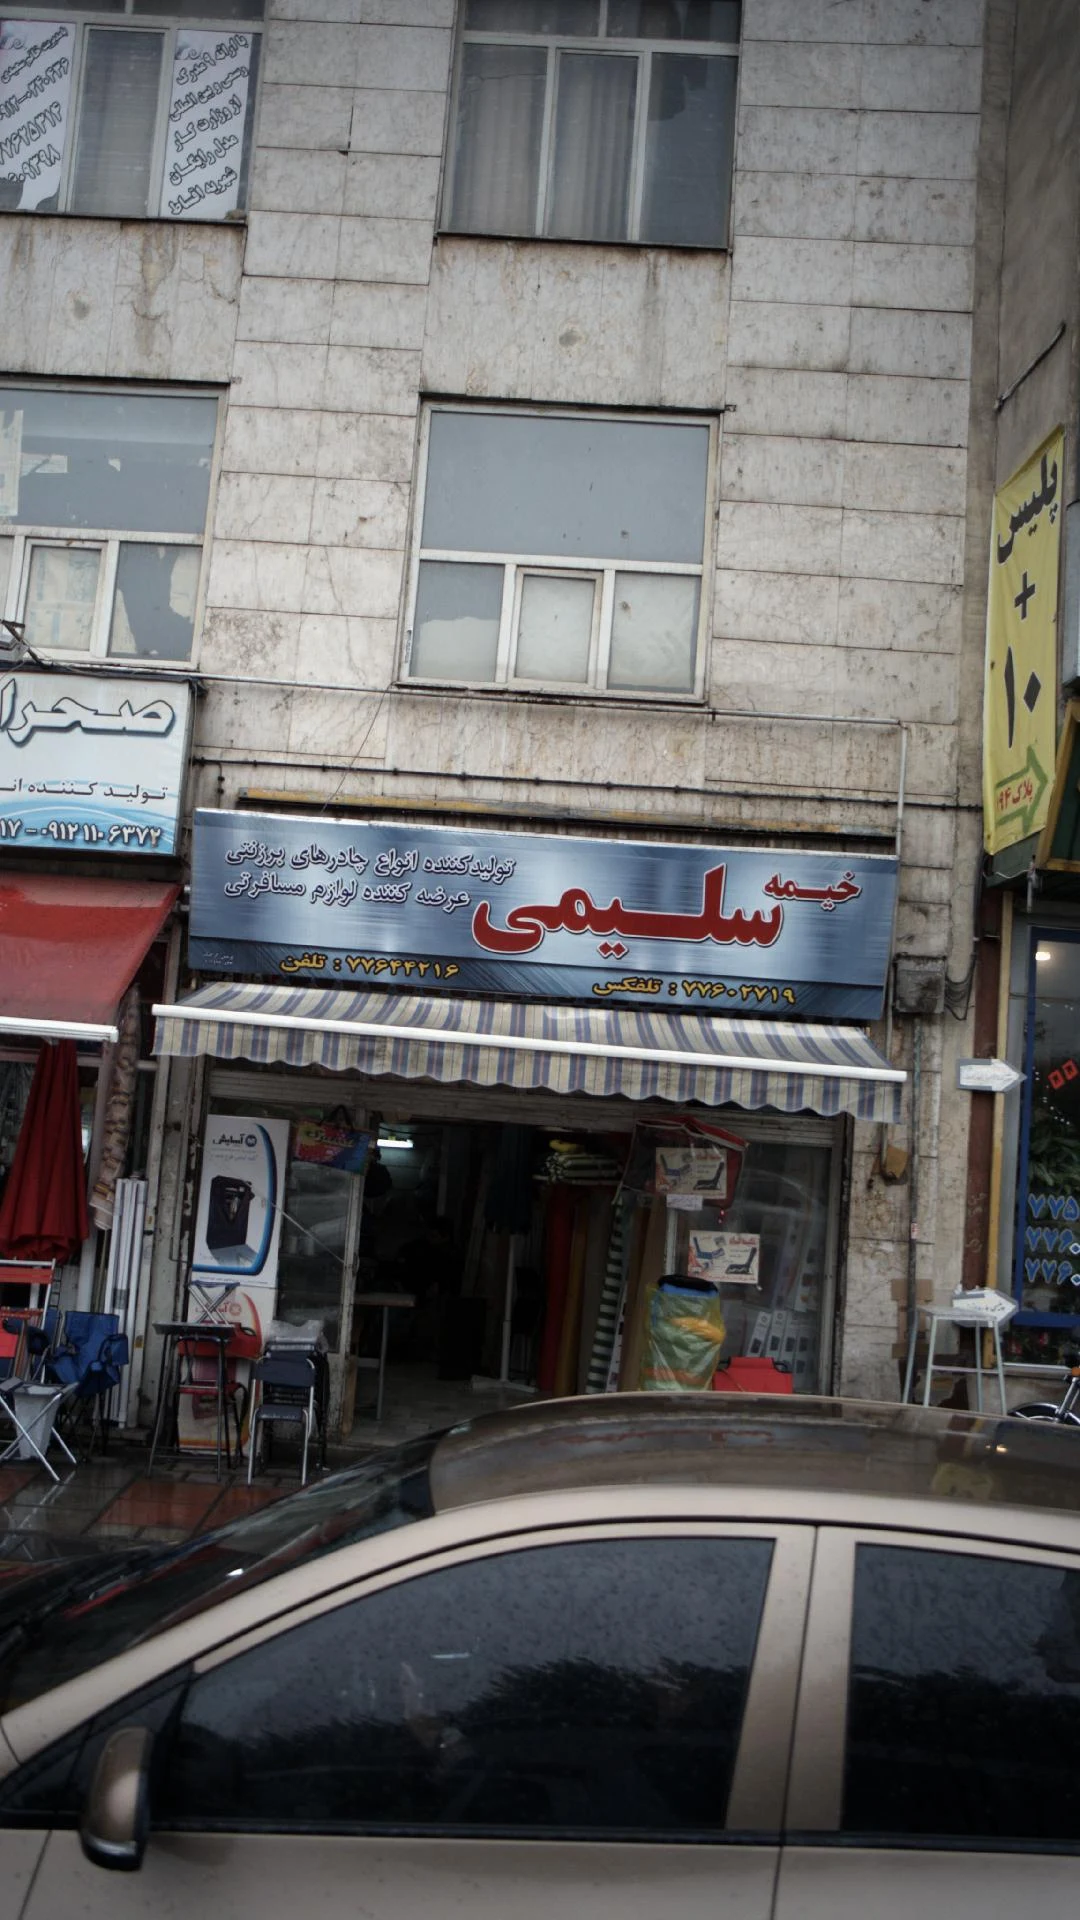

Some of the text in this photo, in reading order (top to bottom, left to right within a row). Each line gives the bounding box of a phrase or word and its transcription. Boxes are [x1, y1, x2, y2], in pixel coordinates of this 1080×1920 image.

[175, 94, 242, 152] از وزارت کار
[169, 133, 239, 186] مدل رایگان
[997, 452, 1058, 565] پلیس
[0, 678, 177, 748] صحرا
[1004, 645, 1042, 749] ۱۰
[27, 781, 98, 796] کننده
[103, 784, 169, 805] تولید
[224, 839, 286, 868] برزنتی
[290, 842, 370, 875] چادرهای
[373, 847, 420, 878] انواع
[223, 870, 471, 914] عرضه کننده لوازم مسافرتی
[472, 863, 784, 960] سلیمی
[762, 870, 862, 912] خیمه
[279, 951, 328, 973] تلفن
[345, 954, 461, 980] ۷۷۶۴۴۲۱۶
[591, 976, 663, 997] تلفکس
[681, 978, 796, 1005] ۷۷۶۰۲۷۱۹
